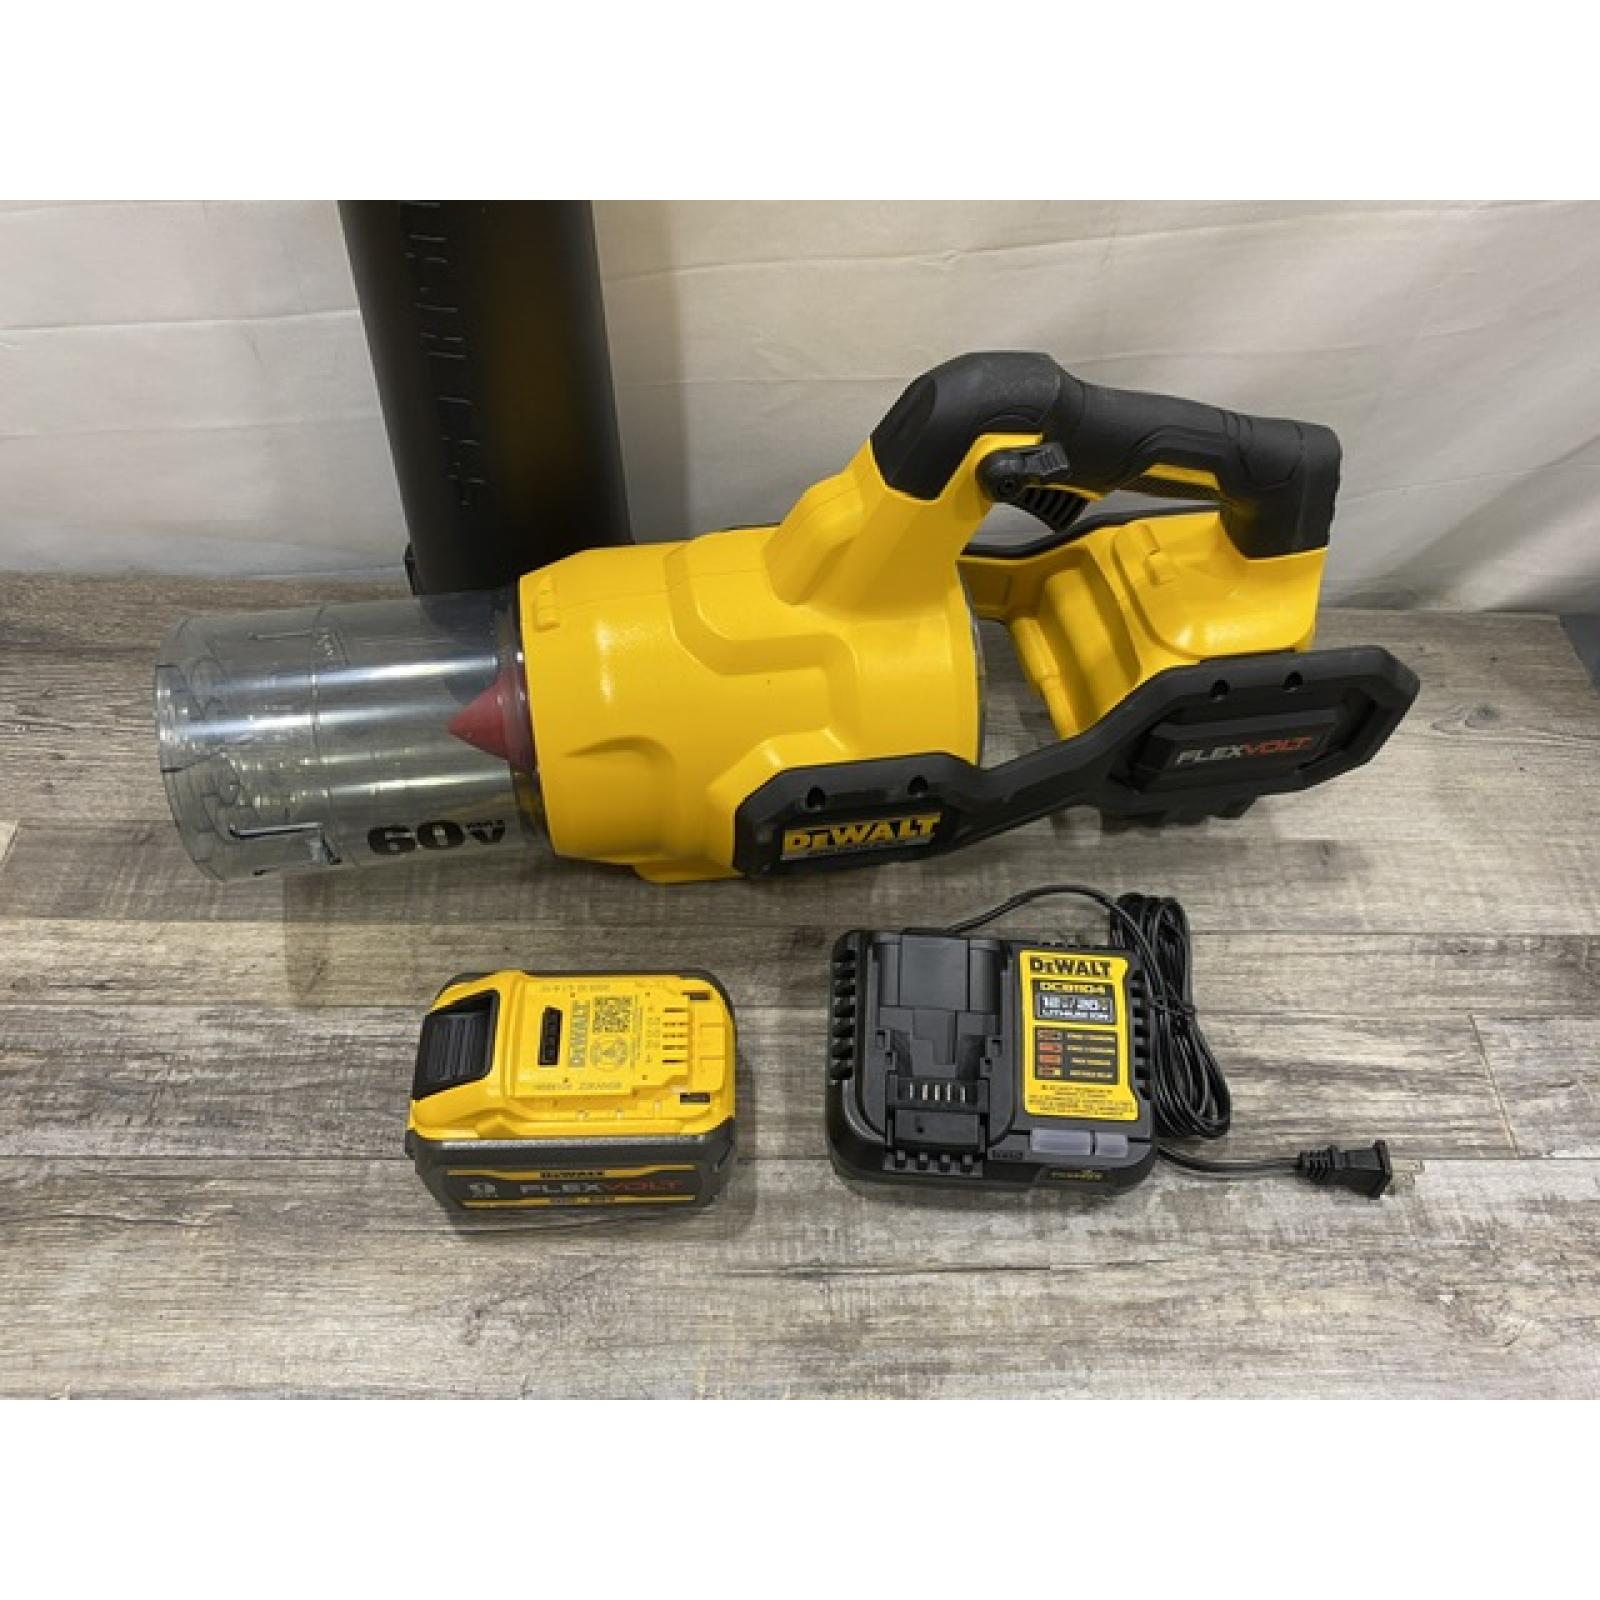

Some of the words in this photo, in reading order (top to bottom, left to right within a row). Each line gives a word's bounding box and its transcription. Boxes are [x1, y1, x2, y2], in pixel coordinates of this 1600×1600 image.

[781, 812, 942, 860] DEWALT
[1030, 956, 1111, 976] DEWALT
[519, 1180, 682, 1195] FLEXVOLT
